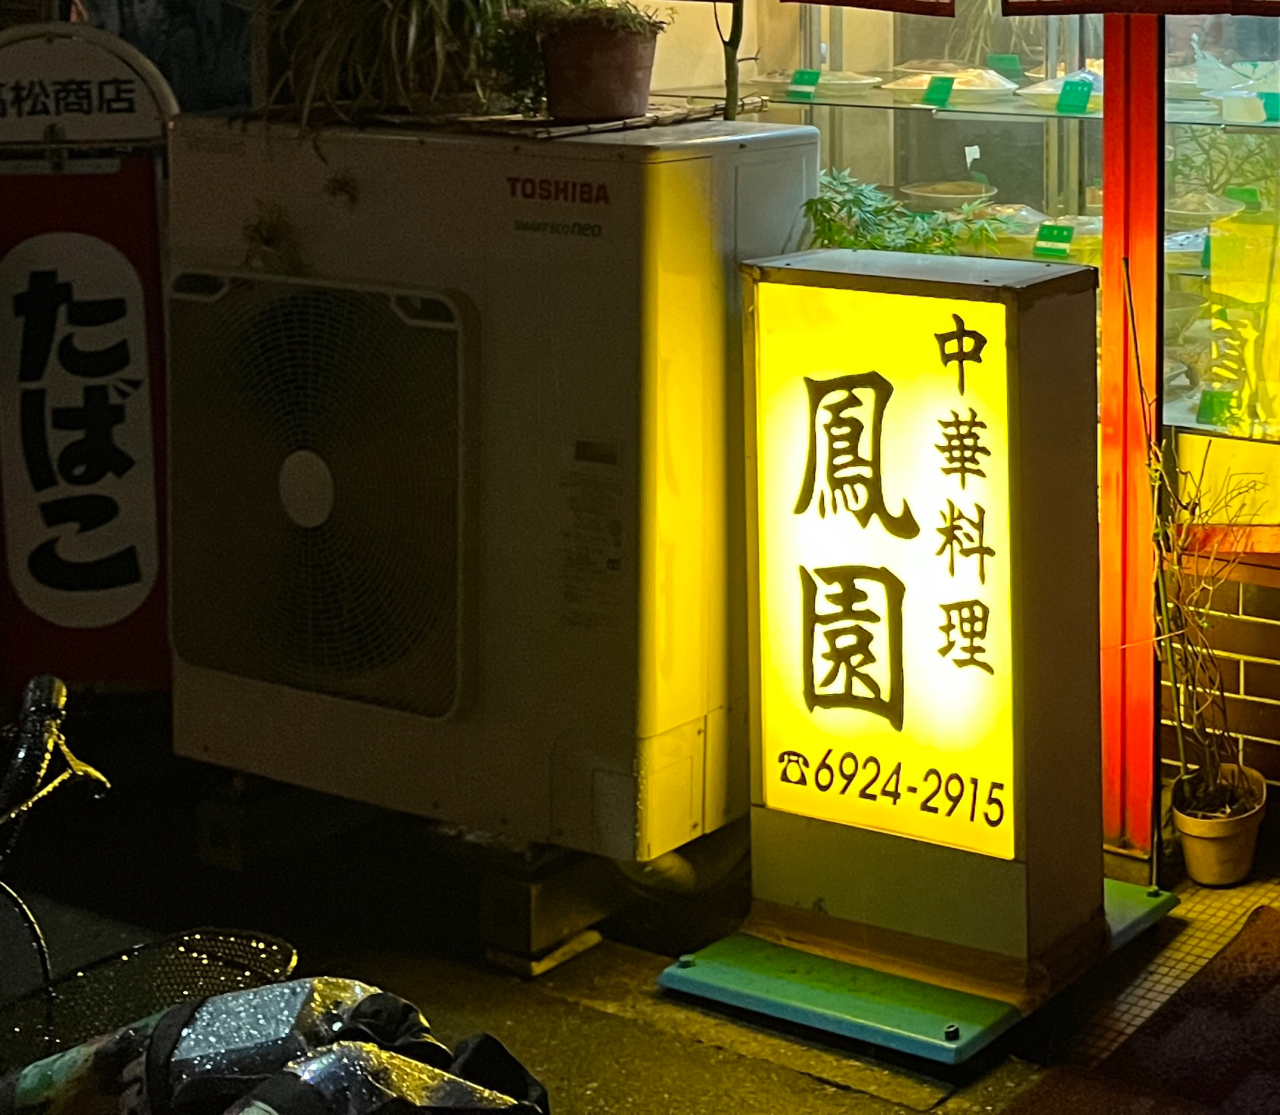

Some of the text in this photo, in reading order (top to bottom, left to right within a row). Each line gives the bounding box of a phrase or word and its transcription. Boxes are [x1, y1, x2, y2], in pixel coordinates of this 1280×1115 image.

[0, 78, 137, 119] 松商店
[506, 176, 612, 205] TOSHIBA
[13, 270, 143, 591] たばこ
[934, 313, 996, 675] 中華料理
[793, 370, 920, 732] 鳳園
[814, 748, 1005, 828] 6924-2915
